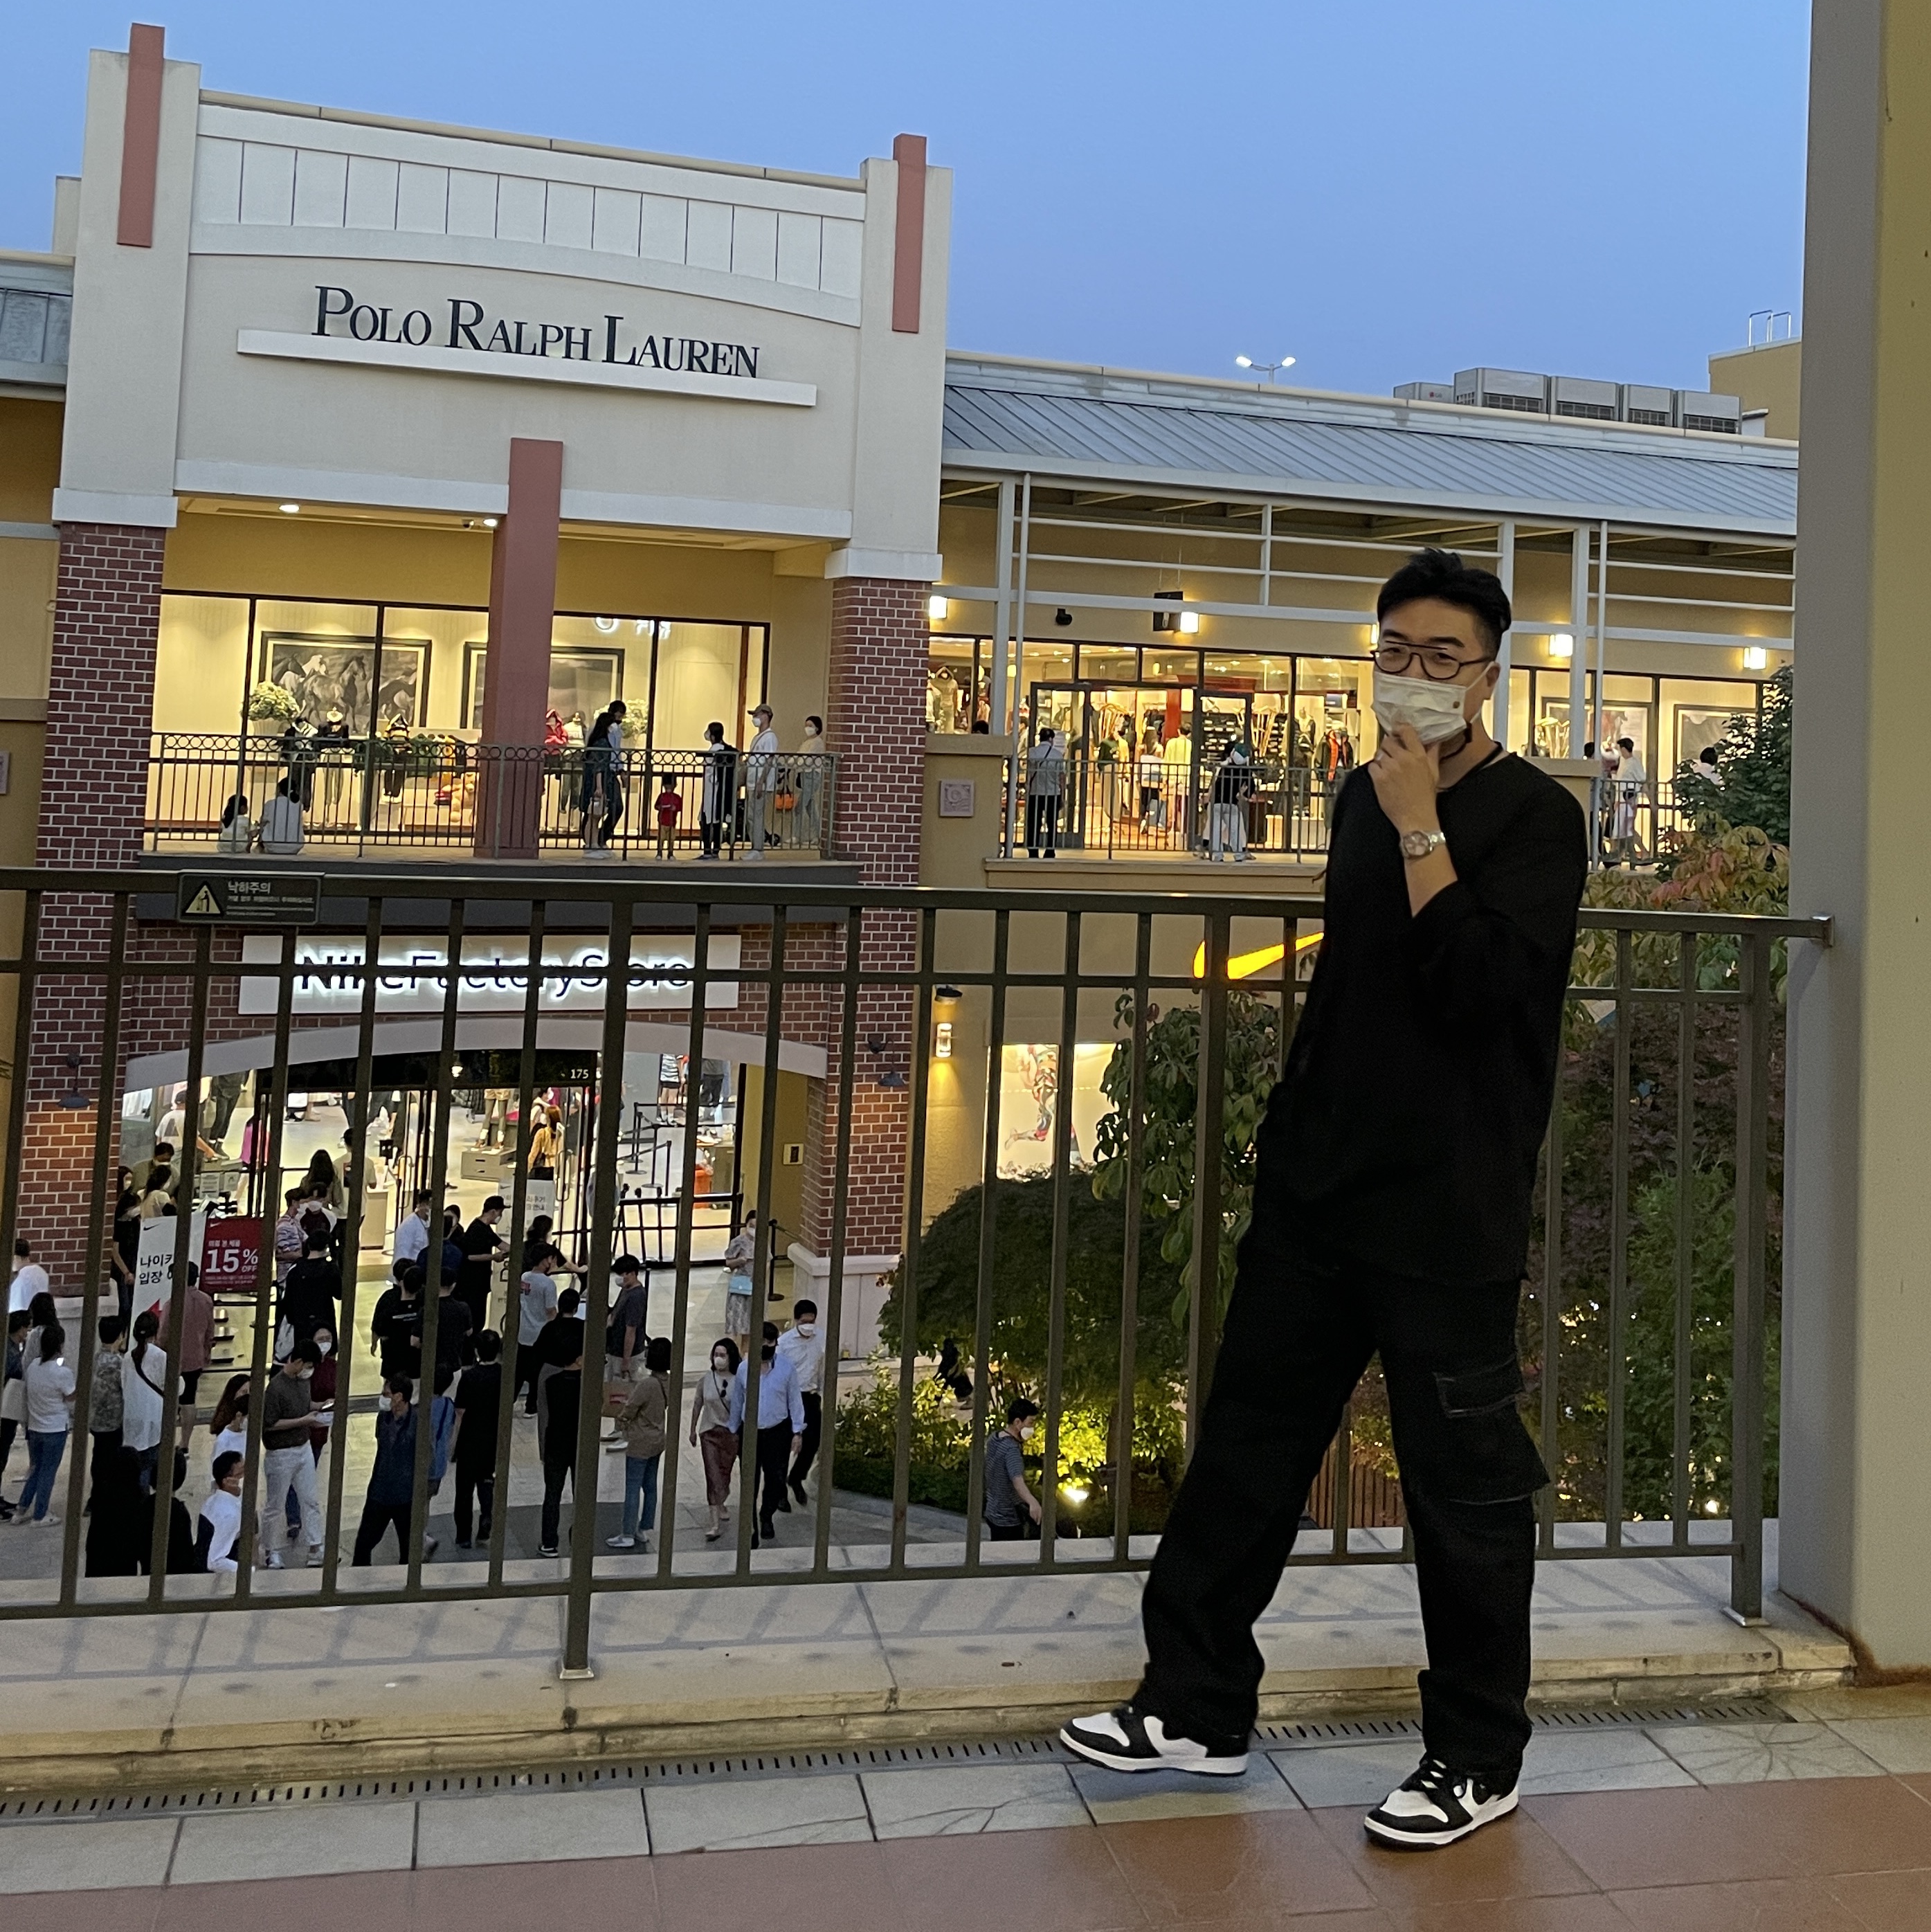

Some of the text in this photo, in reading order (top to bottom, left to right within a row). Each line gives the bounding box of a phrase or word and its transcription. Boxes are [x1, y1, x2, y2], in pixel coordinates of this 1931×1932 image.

[311, 285, 759, 379] POLO RALPH LAUREN
[228, 881, 271, 894] 낙하주의
[302, 955, 688, 997] NieFctySore
[570, 1068, 589, 1078] 175
[242, 1265, 257, 1273] OFF
[139, 1270, 163, 1285] 입장
